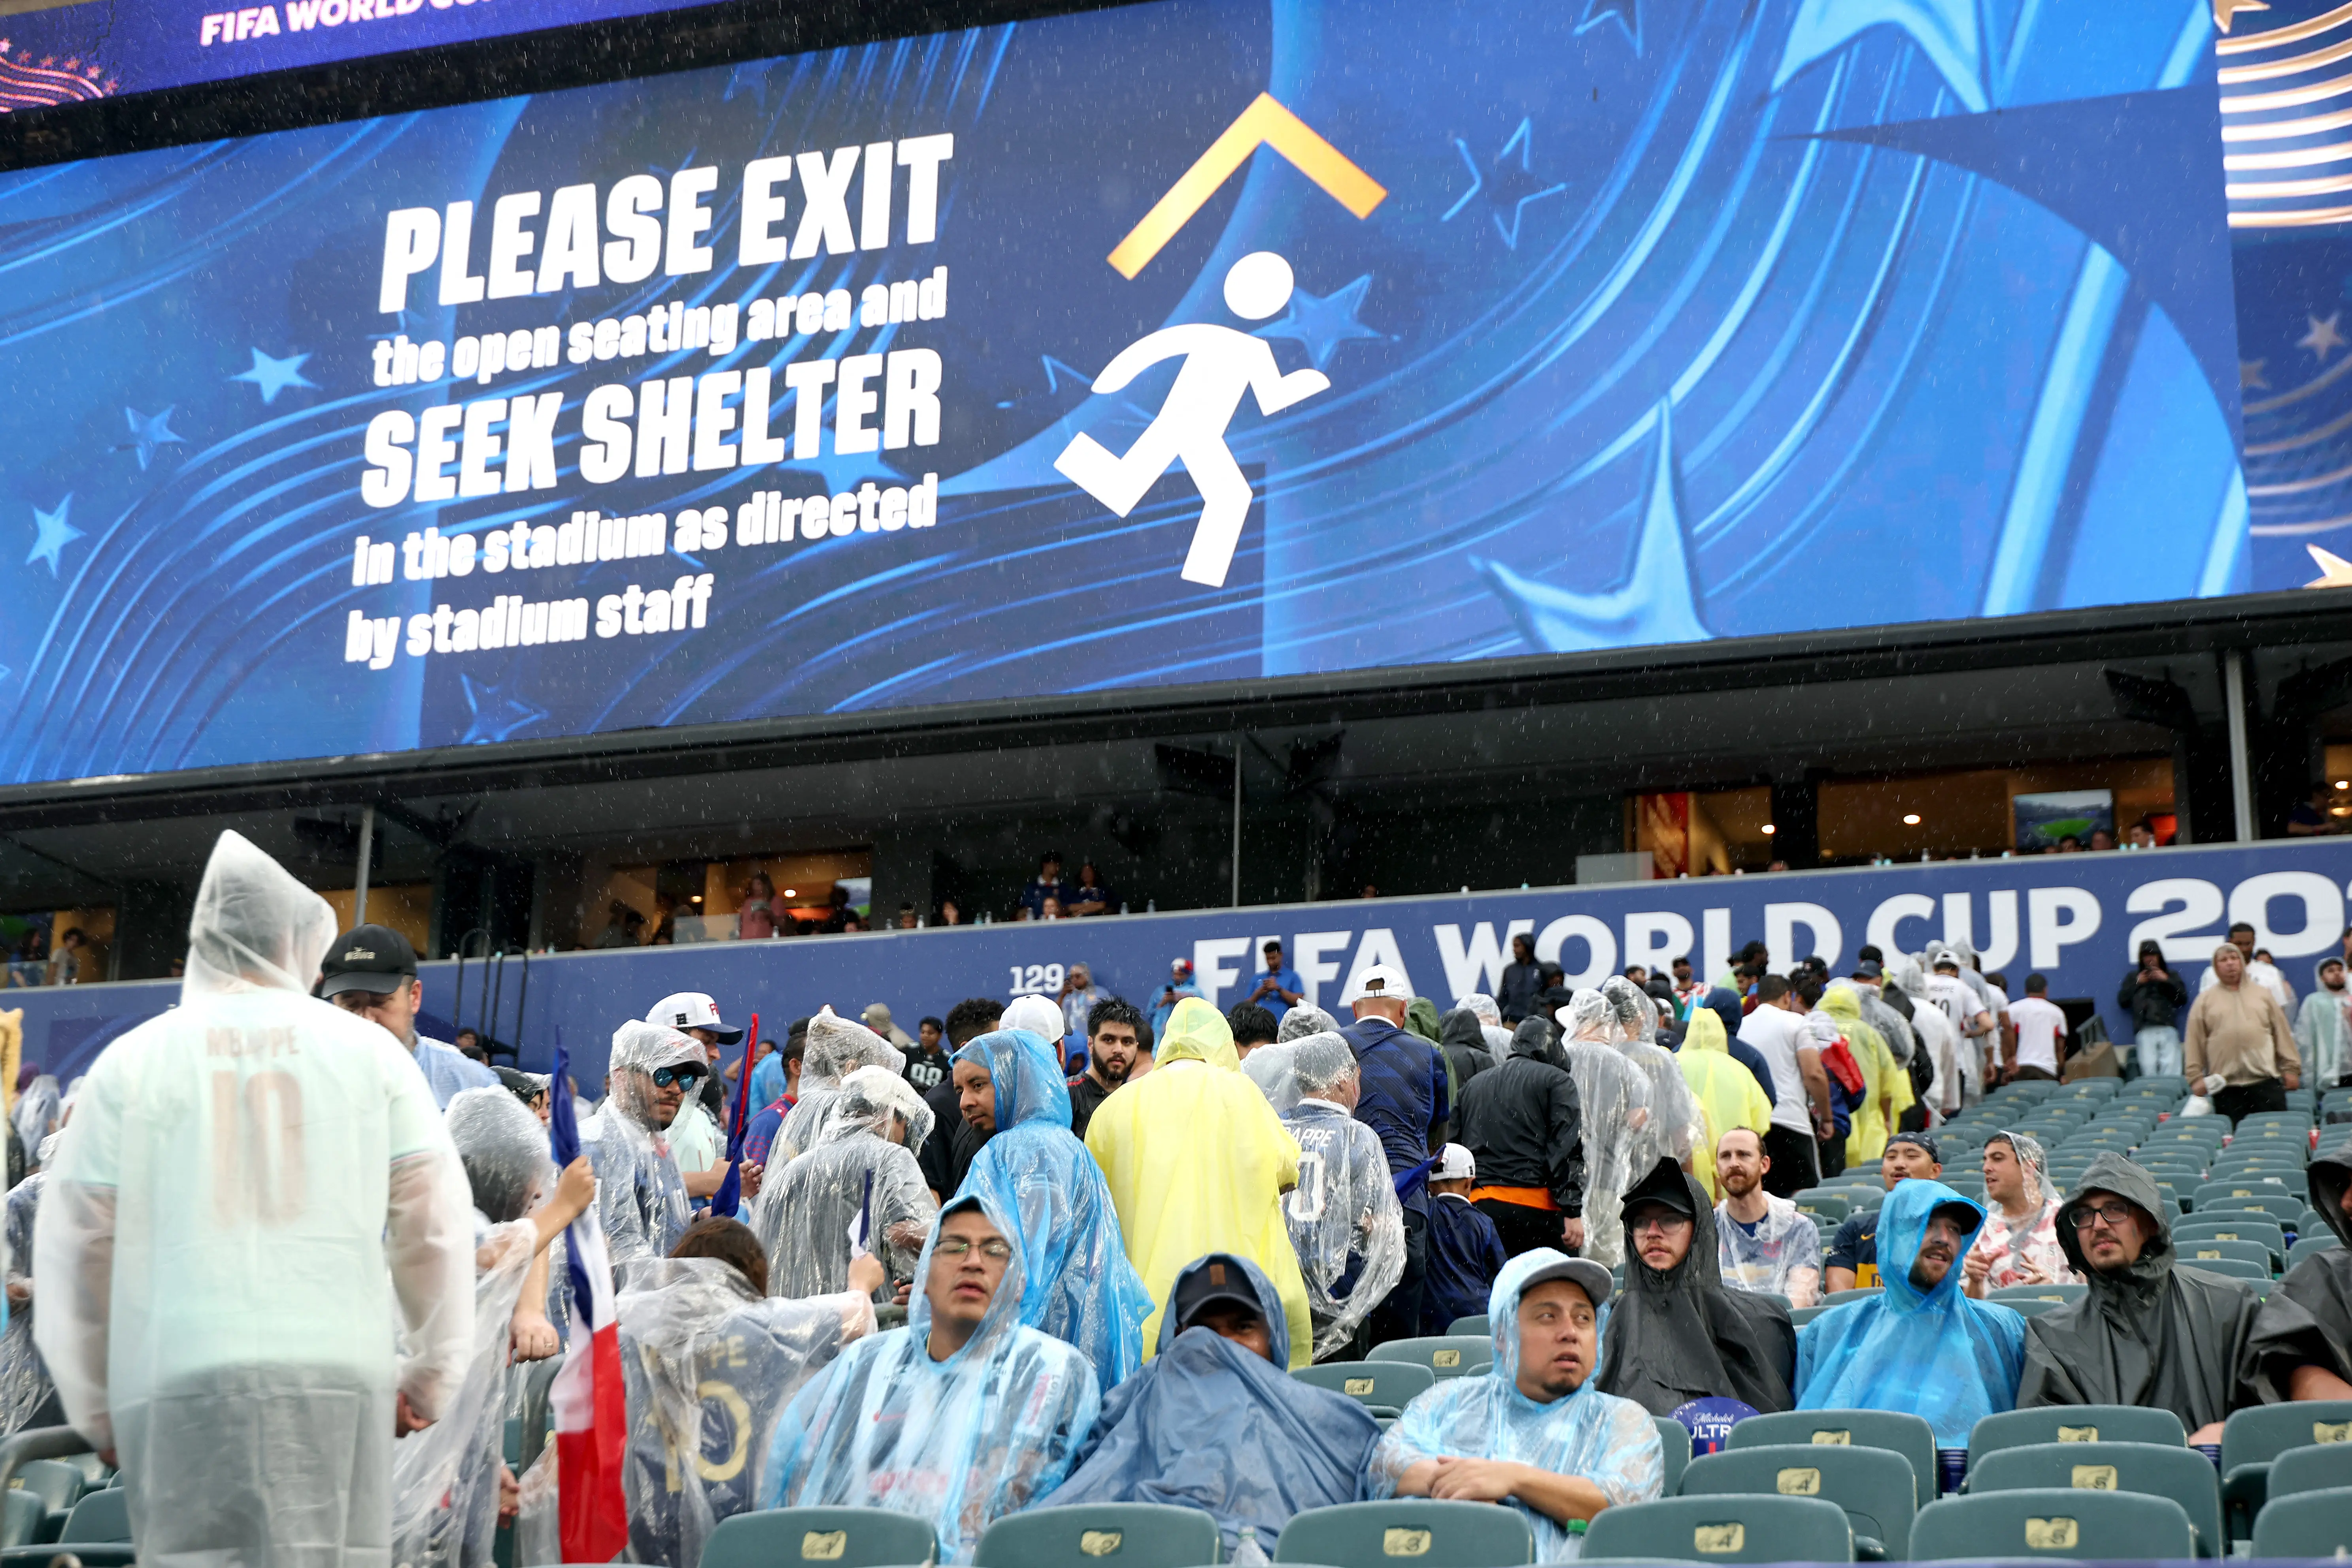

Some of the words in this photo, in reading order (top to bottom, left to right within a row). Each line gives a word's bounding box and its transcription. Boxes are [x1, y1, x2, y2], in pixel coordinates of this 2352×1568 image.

[200, 4, 281, 46] FIFA
[378, 165, 719, 314] PLEASE
[738, 132, 954, 277] EXIT
[372, 334, 445, 387] the
[451, 325, 561, 385] open
[566, 300, 740, 364] seating
[746, 288, 852, 342] area
[859, 265, 948, 328] and
[361, 391, 564, 509] SEEK
[579, 347, 943, 484] SHELTER
[351, 535, 396, 587] in
[401, 526, 477, 581] the
[482, 510, 667, 574] stadium
[673, 506, 729, 554] as
[736, 472, 939, 547] directed
[344, 609, 402, 671] by
[405, 594, 589, 657] stadium
[595, 572, 715, 639] staff
[1866, 887, 2102, 974] CUP
[2127, 870, 2352, 963] 20
[1009, 963, 1065, 996] 129
[213, 1069, 305, 1230] 10
[1285, 1126, 1336, 1147] APPE
